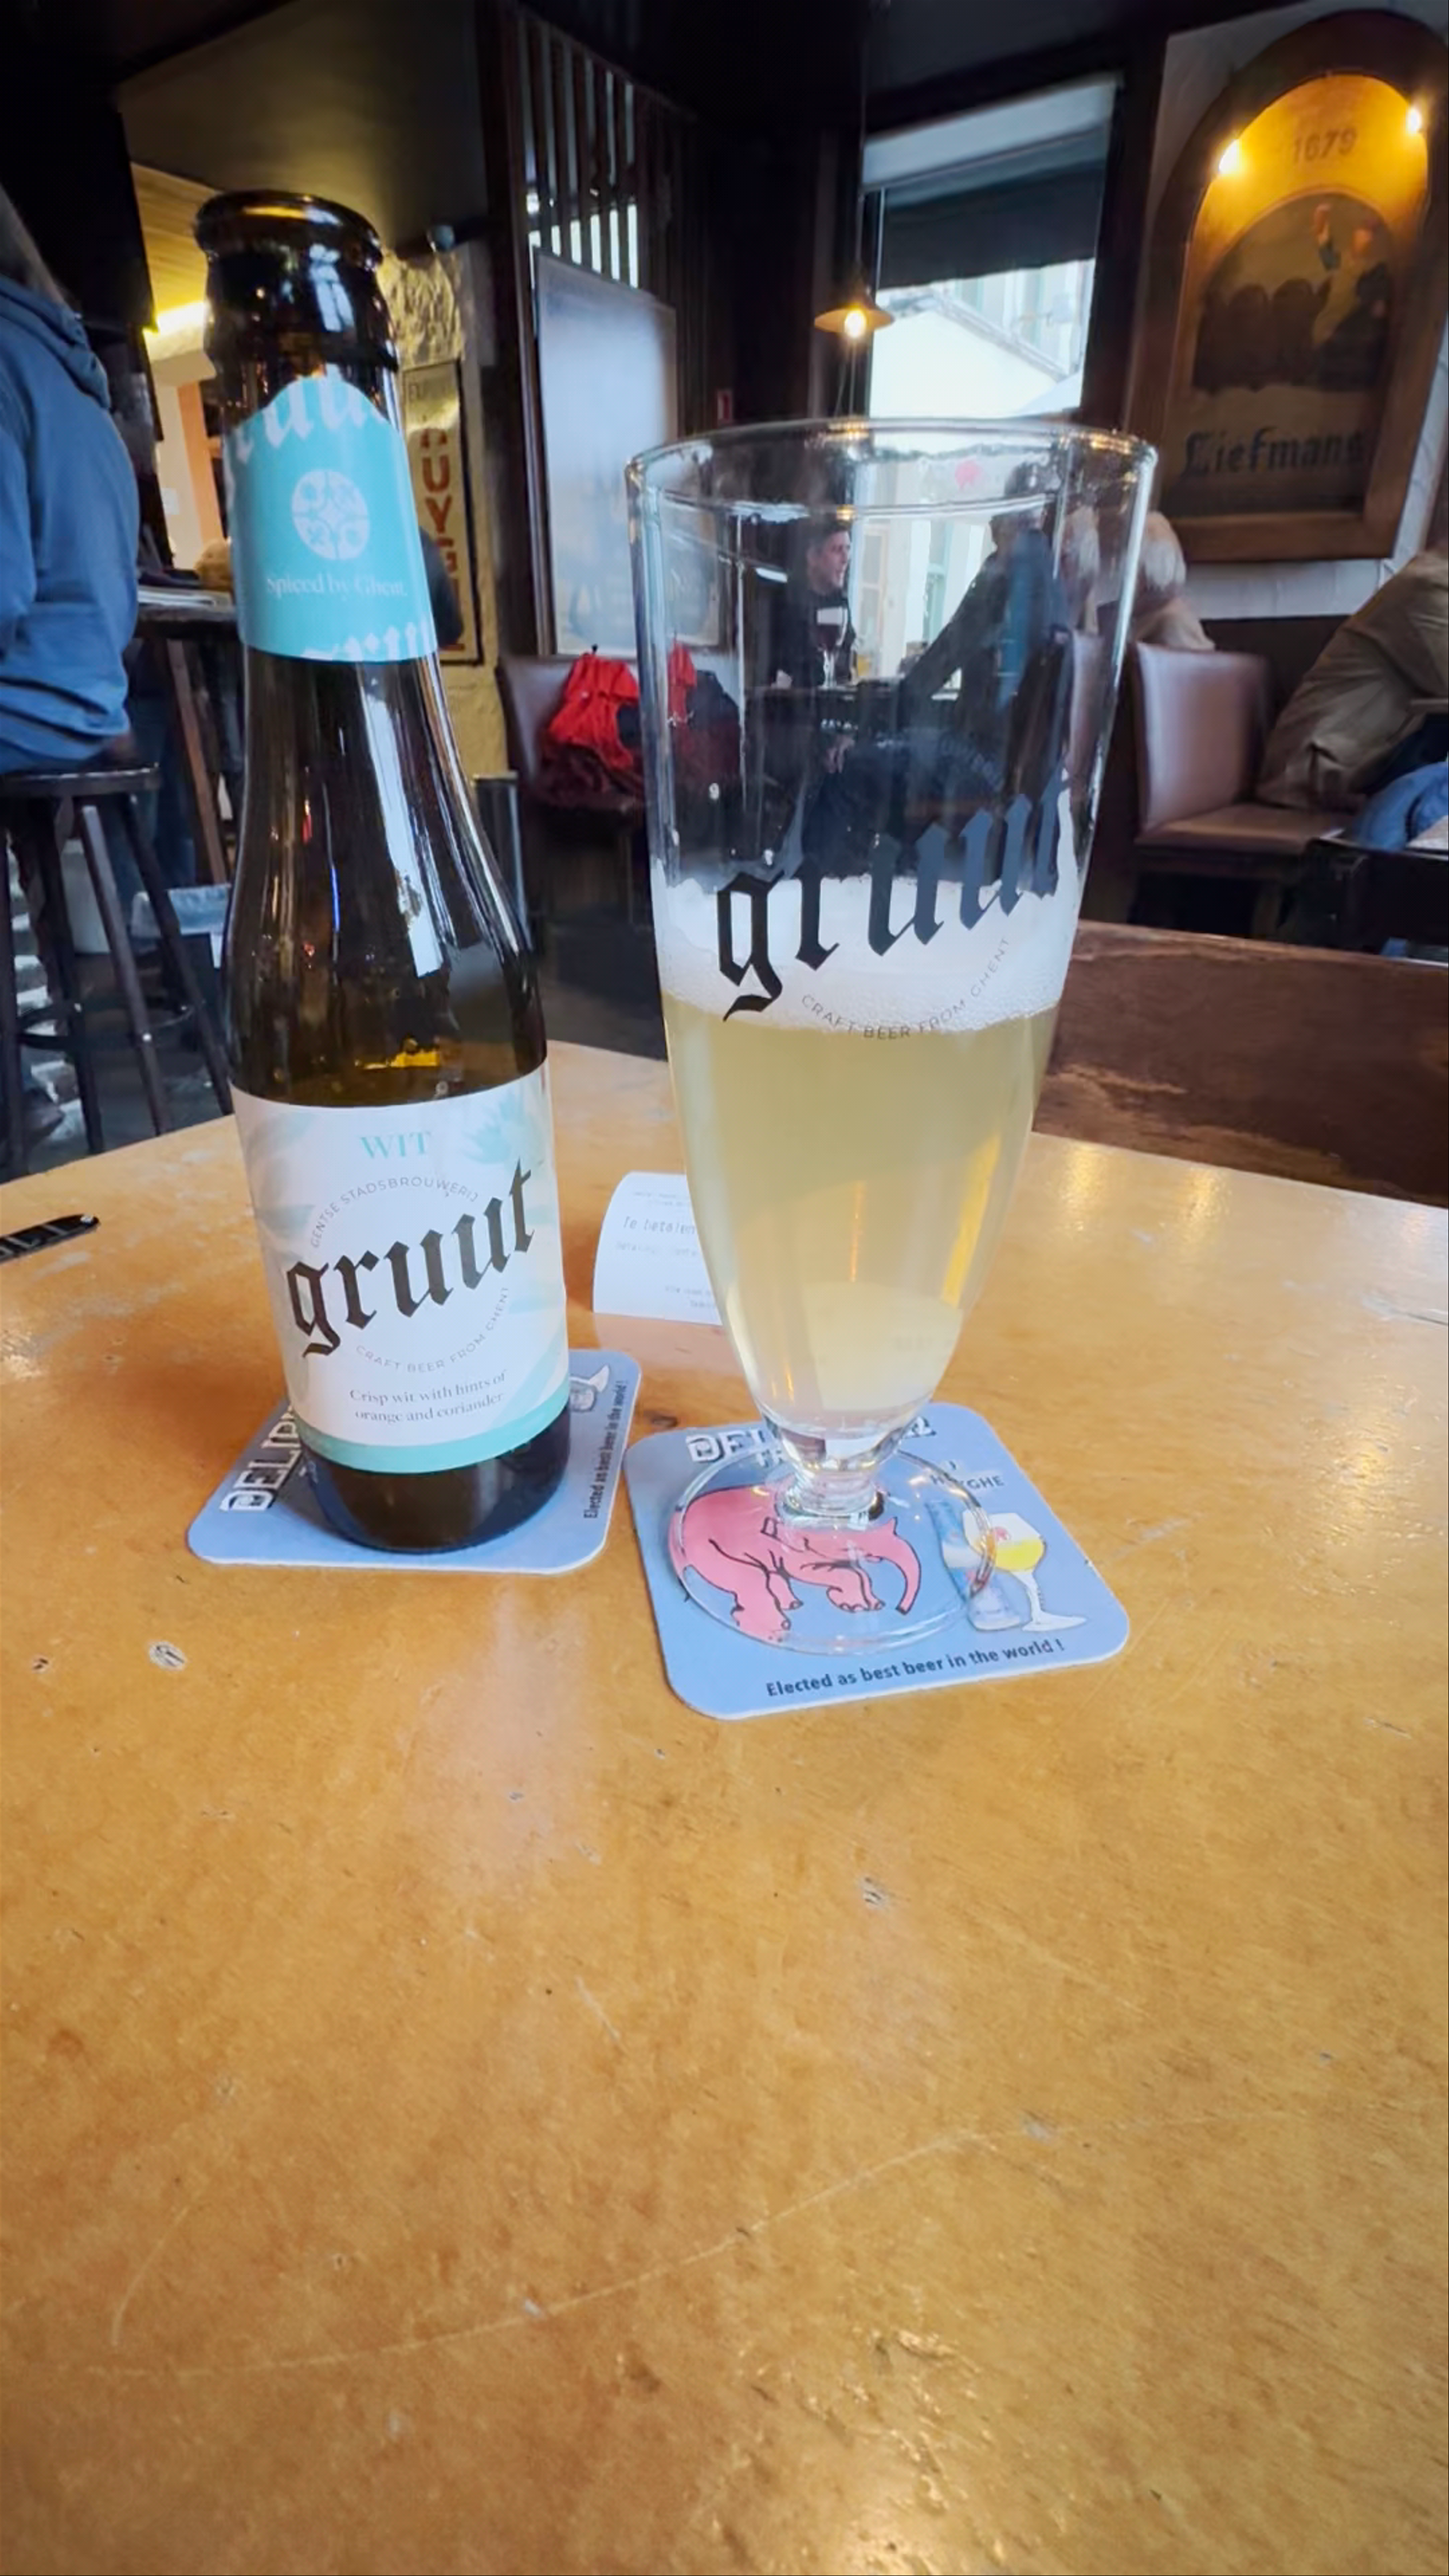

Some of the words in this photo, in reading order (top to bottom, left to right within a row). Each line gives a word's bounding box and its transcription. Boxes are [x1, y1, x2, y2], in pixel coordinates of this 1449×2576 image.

[1292, 127, 1357, 165] 1679
[267, 572, 323, 599] Spiced
[801, 994, 855, 1035] CRAFT
[863, 1026, 911, 1040] BEER
[919, 999, 966, 1033] FROM
[357, 1132, 431, 1159] WIT
[310, 1203, 340, 1248] GENTSE
[340, 1177, 478, 1204] STADSBROUWERIJ
[286, 1157, 535, 1358] gruut
[356, 1345, 400, 1370] CRAFT
[407, 1359, 445, 1373] BEER
[449, 1333, 486, 1363] FROM
[350, 1389, 389, 1406] Crisp
[392, 1391, 415, 1404] wit
[419, 1385, 452, 1401] with
[455, 1380, 490, 1396] hints
[493, 1369, 507, 1384] of
[355, 1410, 403, 1424] orange
[407, 1407, 433, 1421] and
[437, 1392, 505, 1418] coriander
[583, 1484, 605, 1518] Elected
[608, 1408, 622, 1420] the
[766, 1673, 832, 1697] Elected
[838, 1672, 857, 1686] as
[860, 1665, 900, 1682] best
[906, 1658, 943, 1676] beer
[948, 1653, 967, 1669] in
[970, 1646, 999, 1663] the
[1002, 1640, 1054, 1660] world
